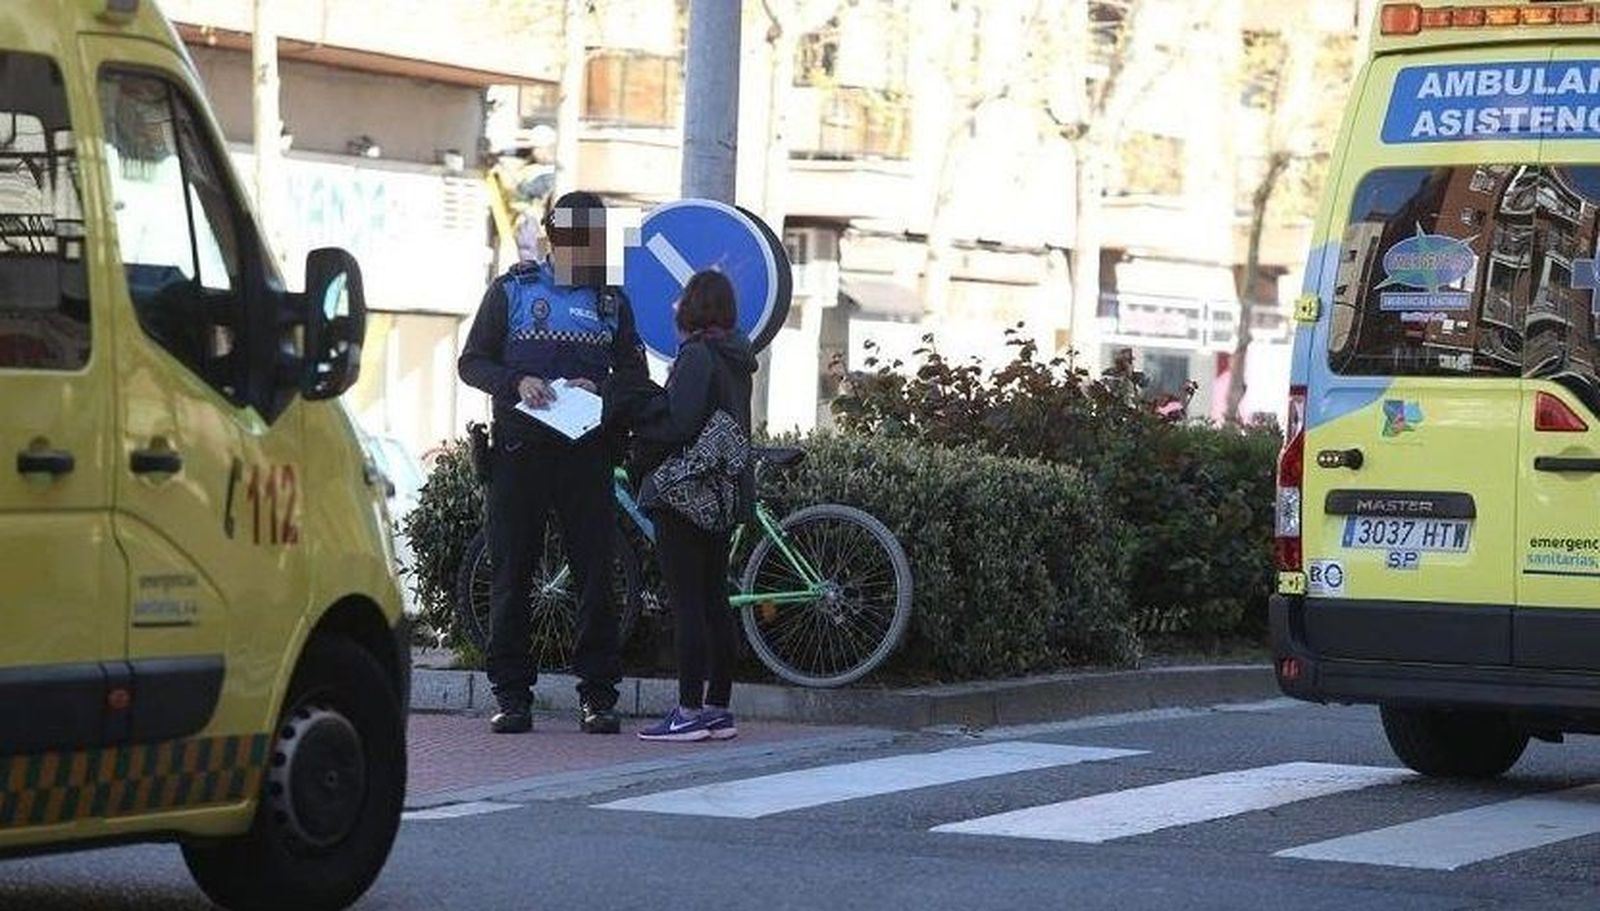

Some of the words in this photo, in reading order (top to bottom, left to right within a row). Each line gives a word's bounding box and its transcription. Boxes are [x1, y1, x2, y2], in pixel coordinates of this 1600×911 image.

[246, 463, 299, 546] 112
[1357, 500, 1433, 512] MASTER
[1358, 519, 1416, 546] 3037
[1422, 522, 1467, 548] HTW
[1388, 551, 1418, 568] SP
